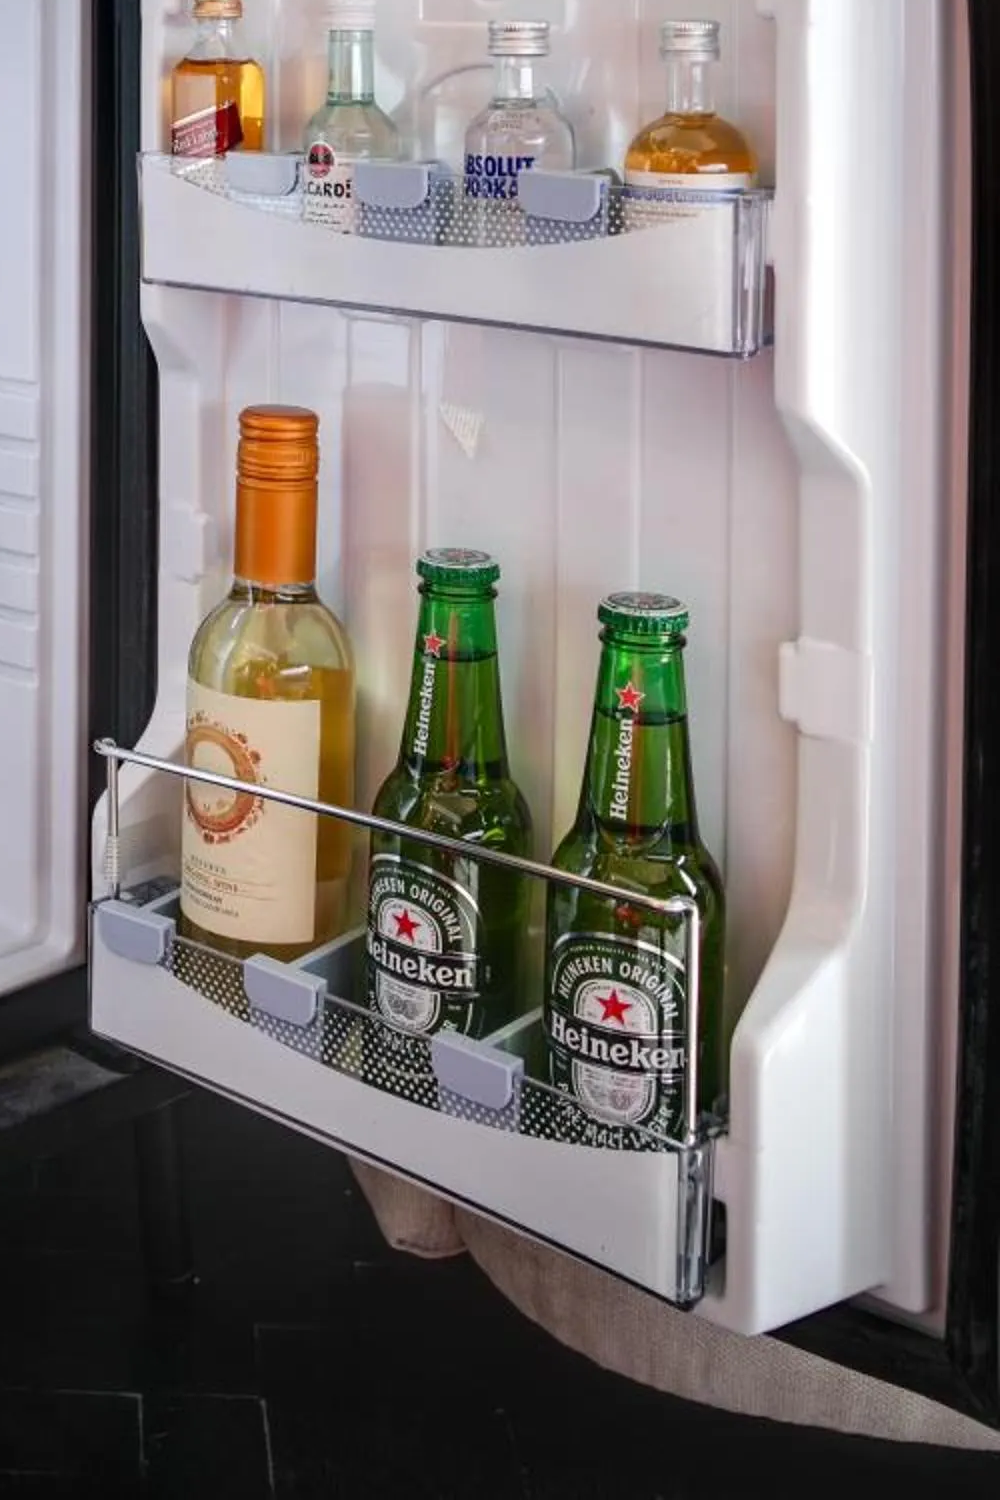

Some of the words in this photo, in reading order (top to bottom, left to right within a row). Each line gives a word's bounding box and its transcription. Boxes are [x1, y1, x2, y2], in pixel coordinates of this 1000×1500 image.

[464, 153, 536, 178] BSOLUT
[412, 658, 436, 757] Heineken
[609, 717, 634, 821] Heineken
[409, 883, 464, 943] ORIGINAL
[558, 954, 614, 1000] HEINEKEN
[619, 962, 679, 1021] ORIGINAL
[551, 1010, 687, 1069] Heineken
